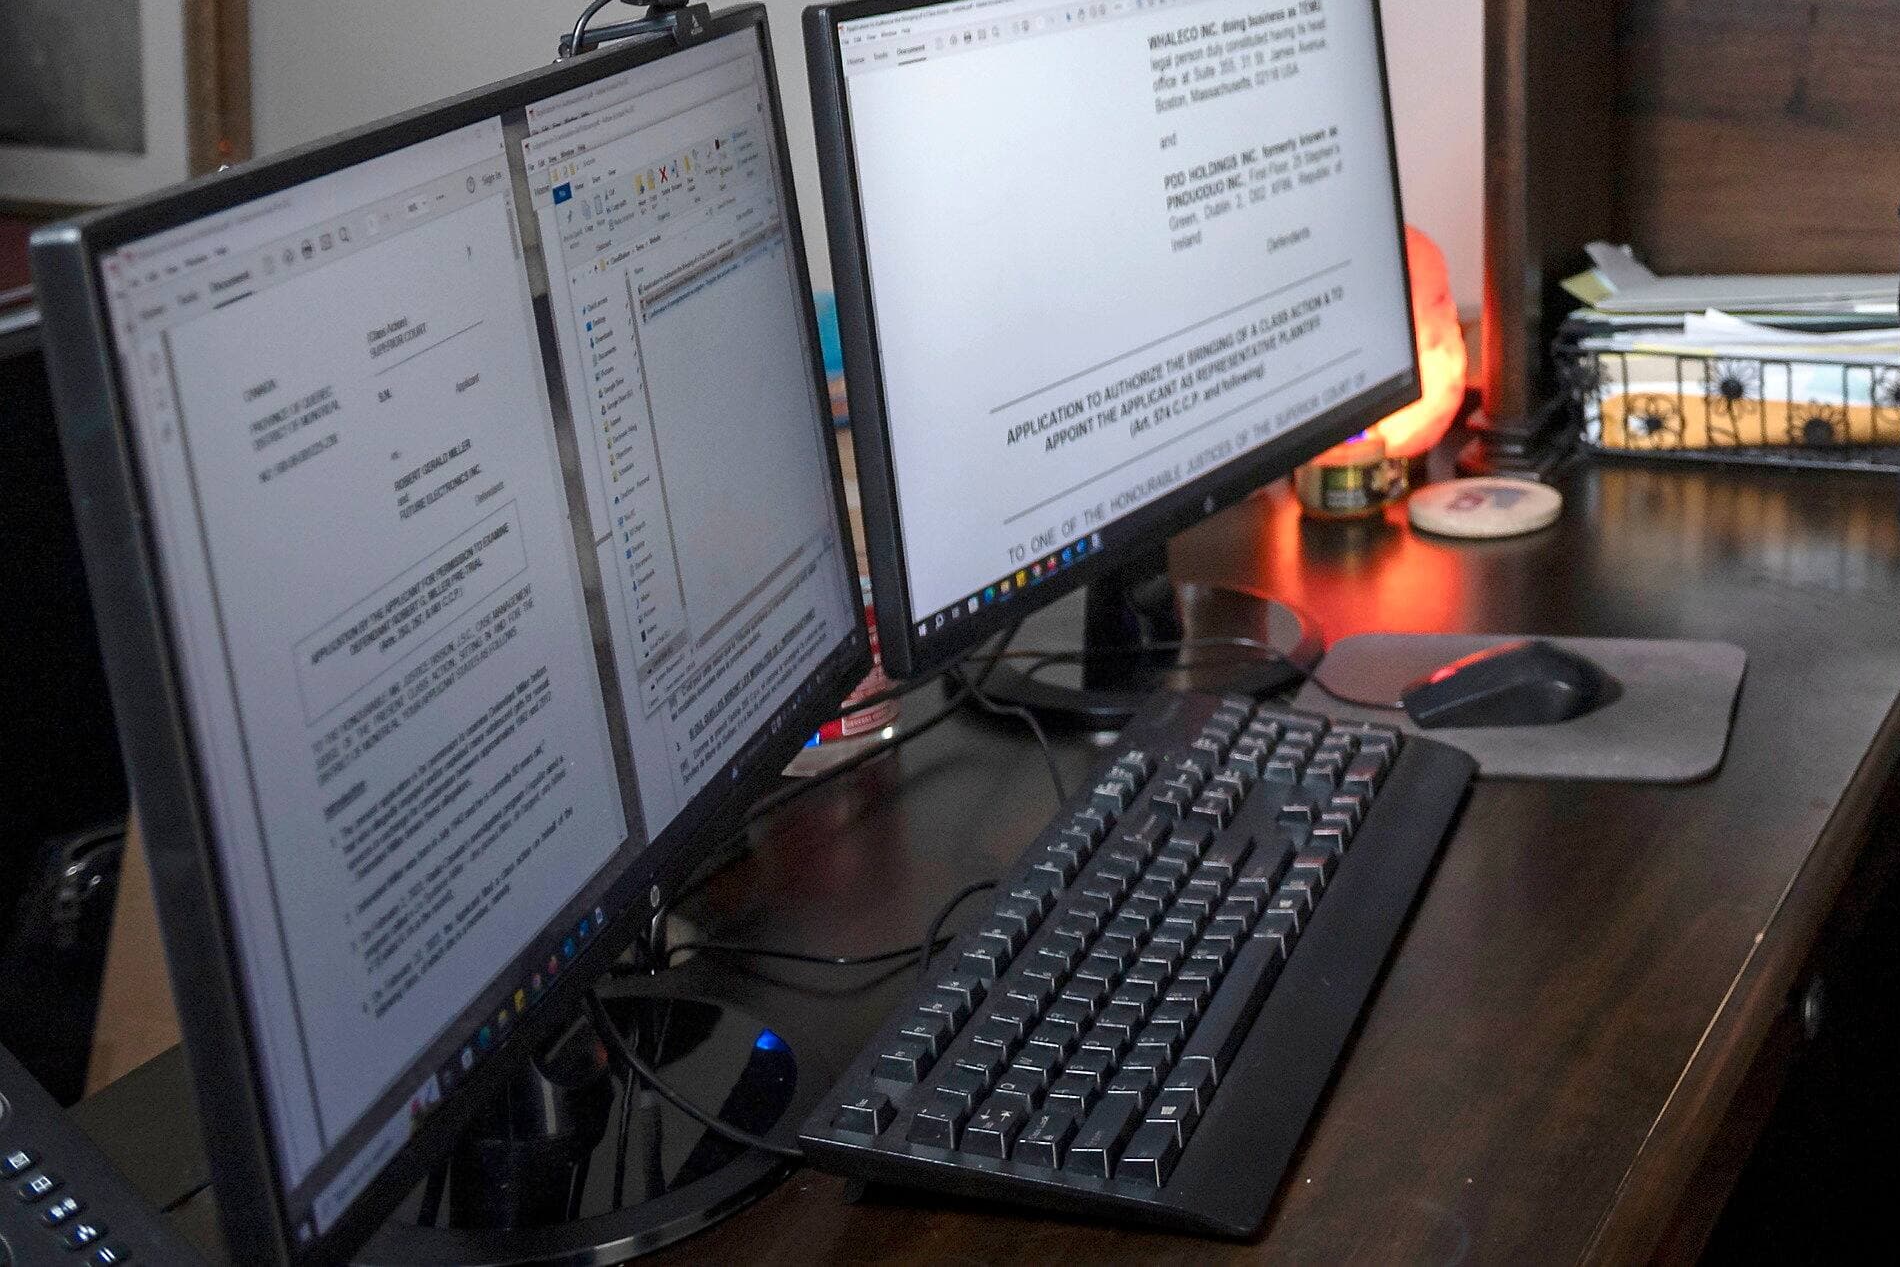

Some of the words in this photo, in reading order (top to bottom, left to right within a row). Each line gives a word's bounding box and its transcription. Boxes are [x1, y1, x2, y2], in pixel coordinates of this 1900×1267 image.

[1148, 27, 1198, 50] WHALECO
[1221, 18, 1247, 34] doing
[1248, 9, 1286, 28] business
[1160, 133, 1177, 150] and
[1189, 155, 1238, 181] HOLDINGS
[370, 334, 404, 359] SUPERIOR
[403, 323, 426, 342] COURT
[1007, 401, 1084, 445] APPLICATION
[1086, 391, 1101, 410] TO
[1104, 364, 1163, 401] AUTHORIZE
[1166, 354, 1185, 373] THE
[1187, 334, 1234, 365] BRINGING
[1259, 310, 1289, 333] CLASS
[1291, 296, 1322, 319] ACTION
[1203, 382, 1220, 402] and
[1221, 364, 1265, 392] following)
[1045, 417, 1093, 452] APPOINT
[1096, 406, 1118, 428] THE
[1121, 380, 1177, 417] APPLICANT
[1180, 373, 1193, 390] AS
[1196, 336, 1276, 381] REPRESENTATIVE
[394, 468, 421, 492] ROBERT
[421, 453, 449, 475] GERALD
[1031, 528, 1056, 554] ONE
[1083, 503, 1106, 525] THE
[1110, 466, 1181, 512] HONOURABLE
[1187, 440, 1232, 475] JUSTICES
[1253, 420, 1271, 439] THE
[400, 498, 426, 520] FUTURE
[426, 471, 469, 505] ELECTRONICS
[311, 626, 359, 664] APPLICATION
[385, 582, 421, 615] APPLICANT
[435, 547, 474, 580] PERMISSION
[492, 584, 531, 620] MANAGEMENT
